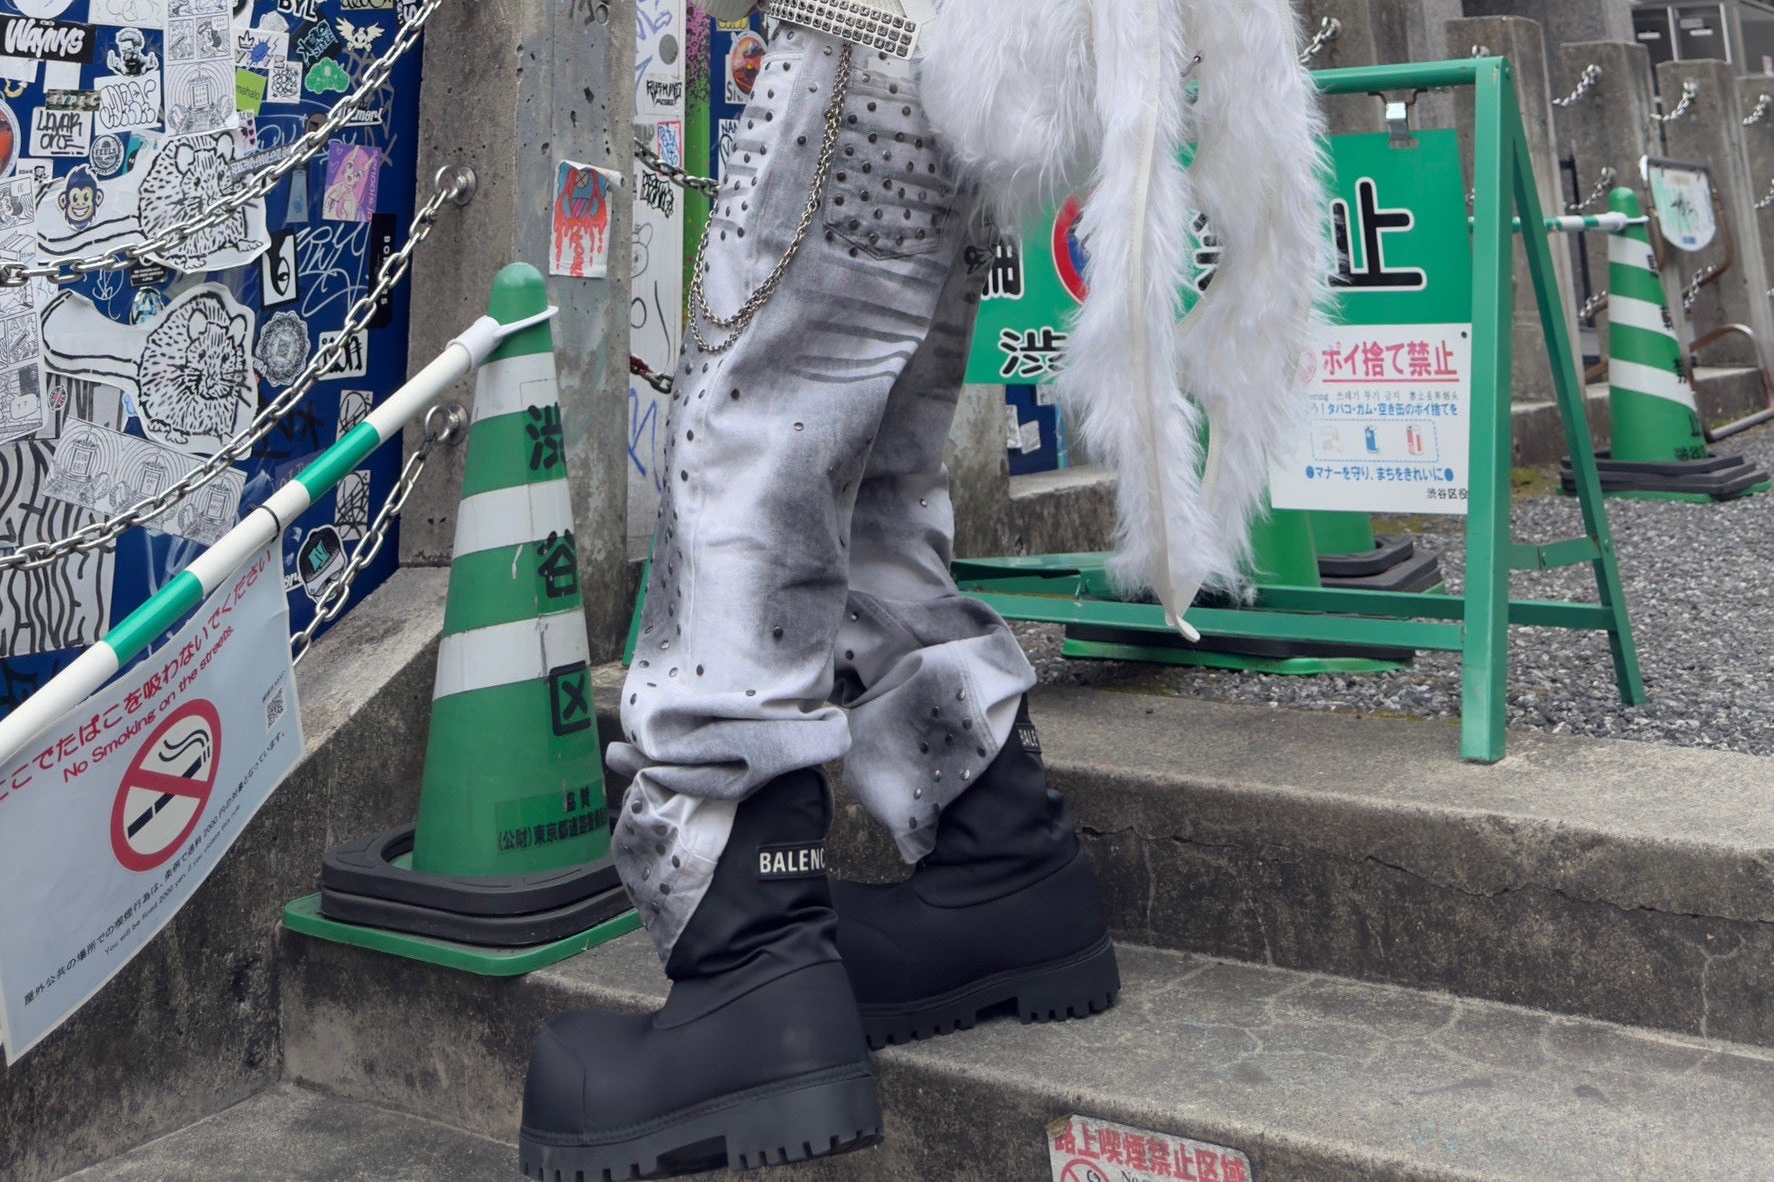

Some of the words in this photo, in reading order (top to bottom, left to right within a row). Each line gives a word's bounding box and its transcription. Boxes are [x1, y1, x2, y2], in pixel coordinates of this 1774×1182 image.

[1321, 339, 1458, 377] ポイ捨て禁止
[63, 760, 89, 784] No
[91, 708, 156, 764] Smoking
[159, 691, 176, 711] on
[178, 668, 198, 693] the
[104, 942, 119, 955] You
[158, 883, 174, 904] 2000
